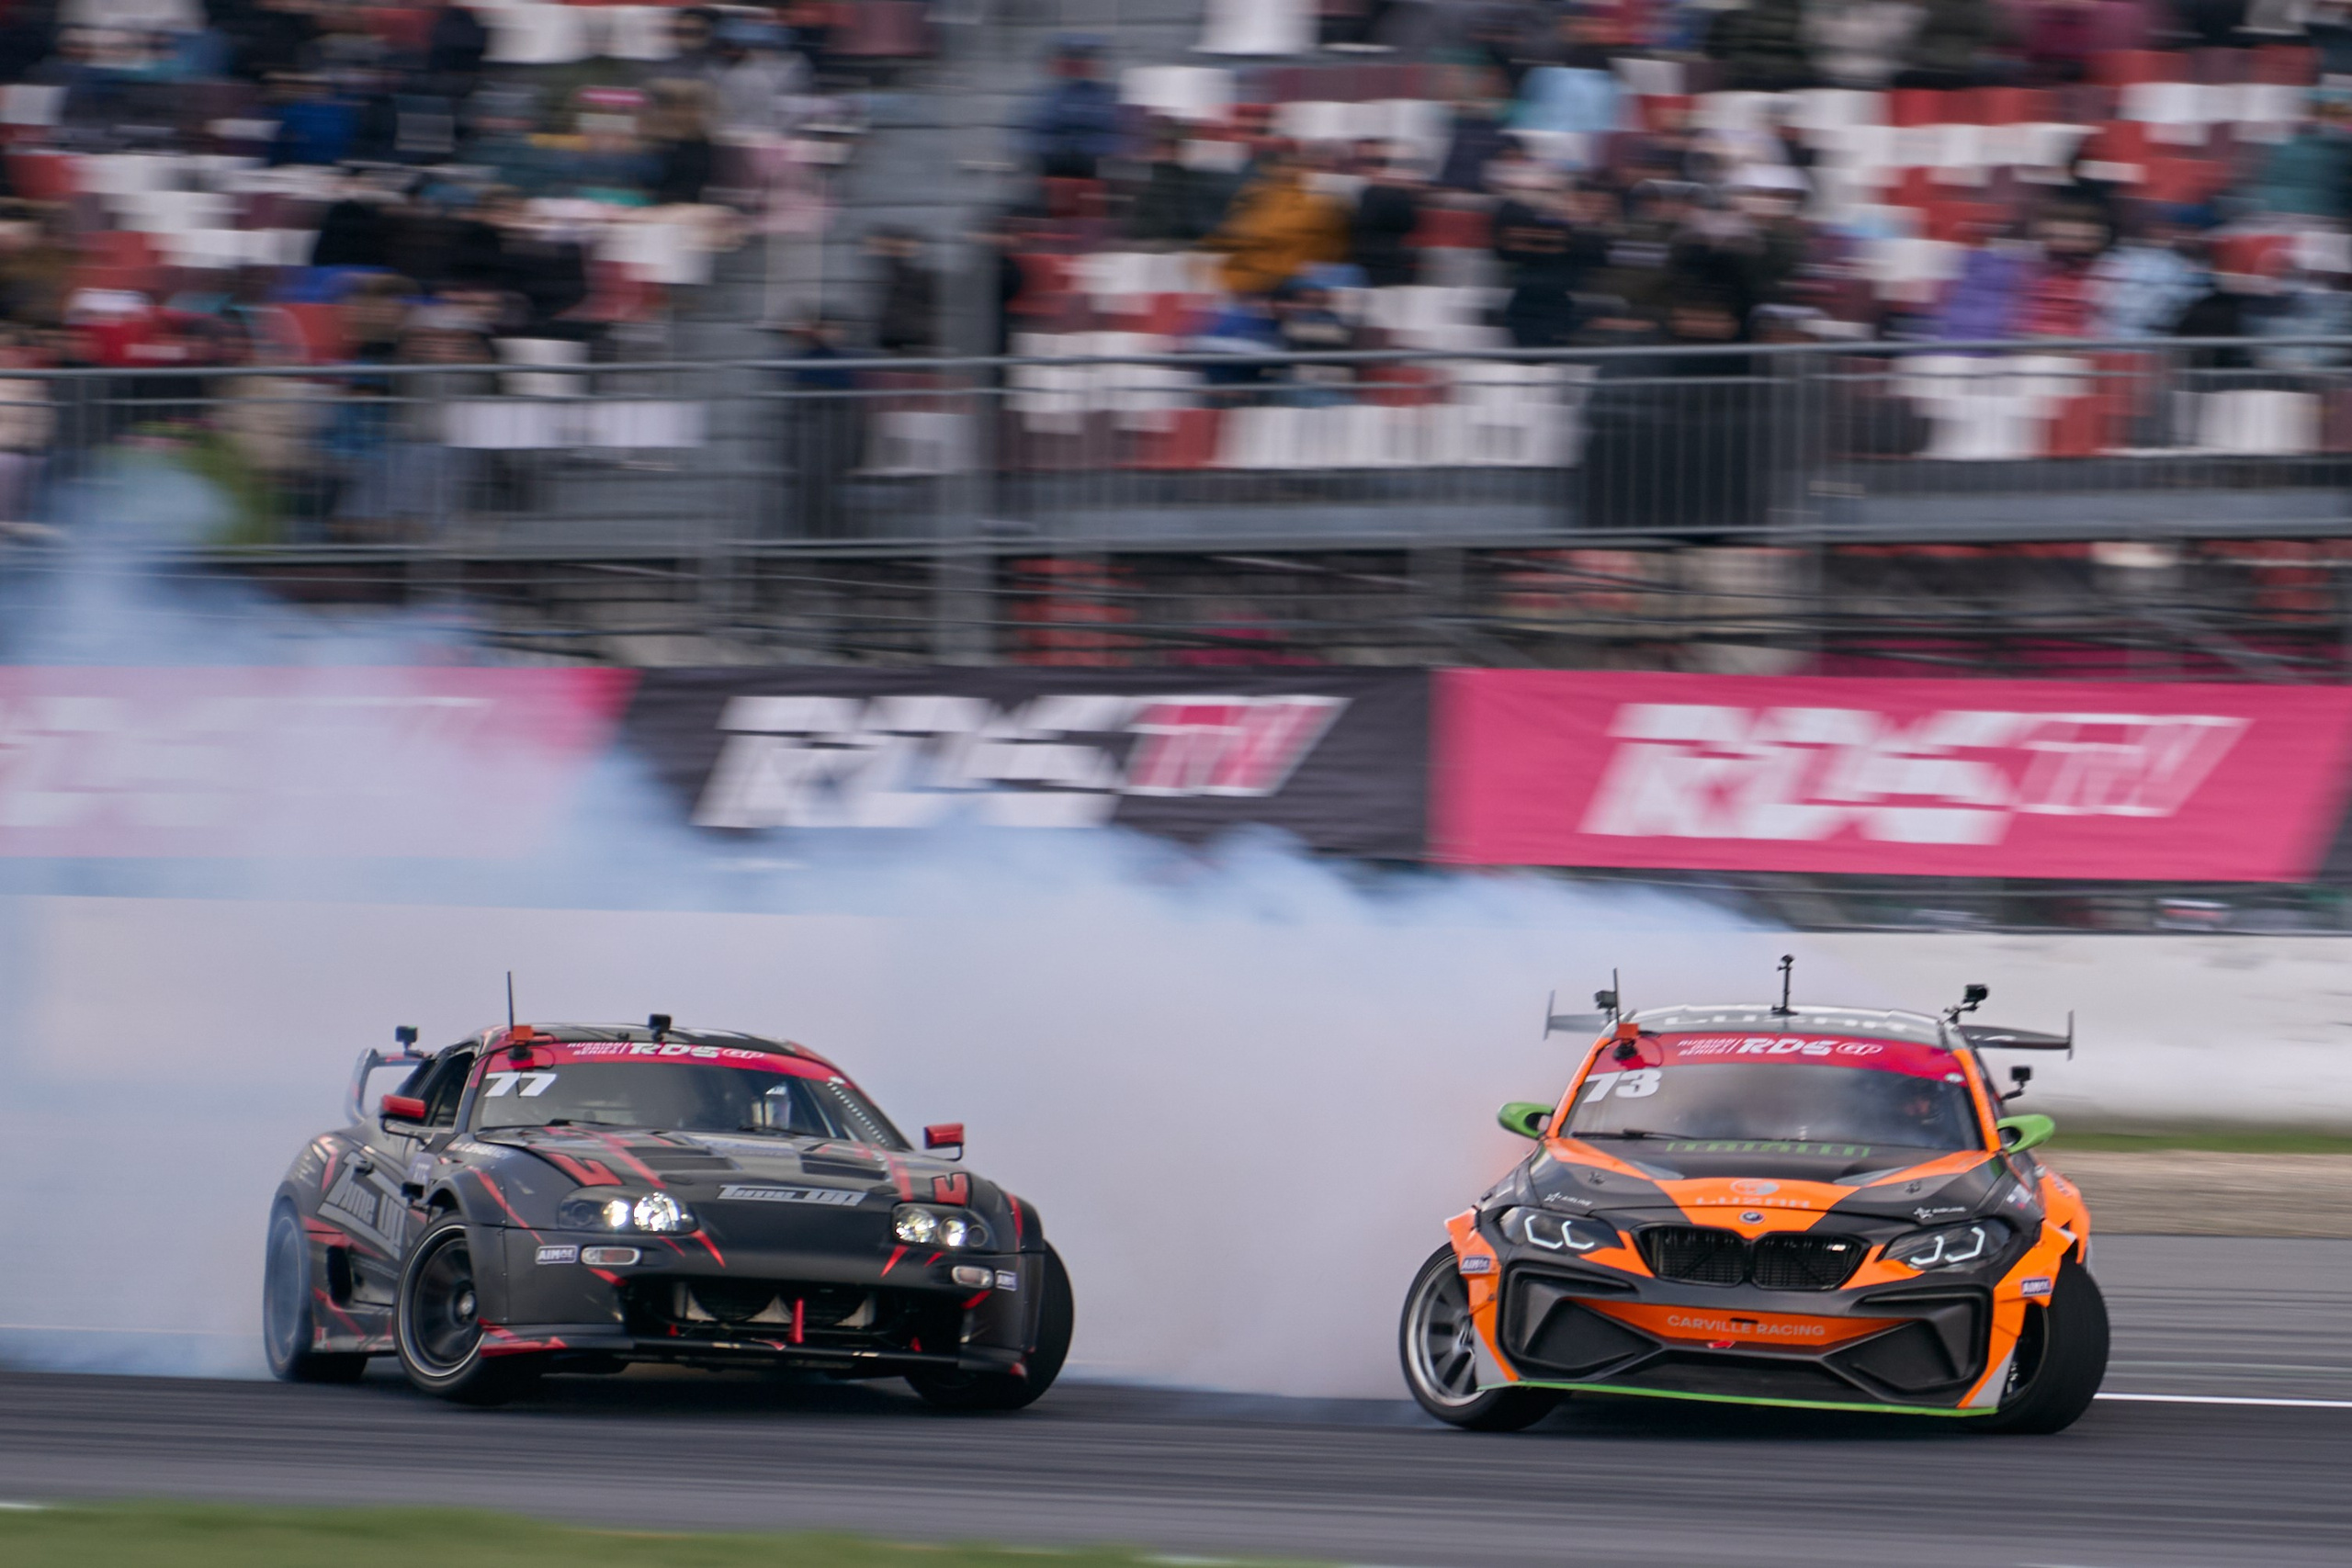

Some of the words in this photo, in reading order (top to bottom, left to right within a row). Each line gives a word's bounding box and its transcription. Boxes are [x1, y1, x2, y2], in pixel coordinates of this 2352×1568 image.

[629, 1043, 719, 1058] RDS
[1736, 1037, 1839, 1056] RDS
[484, 1072, 557, 1097] 77
[1583, 1068, 1662, 1103] 73
[1667, 1314, 1752, 1334] CARVILLE
[1757, 1324, 1826, 1337] RACING
